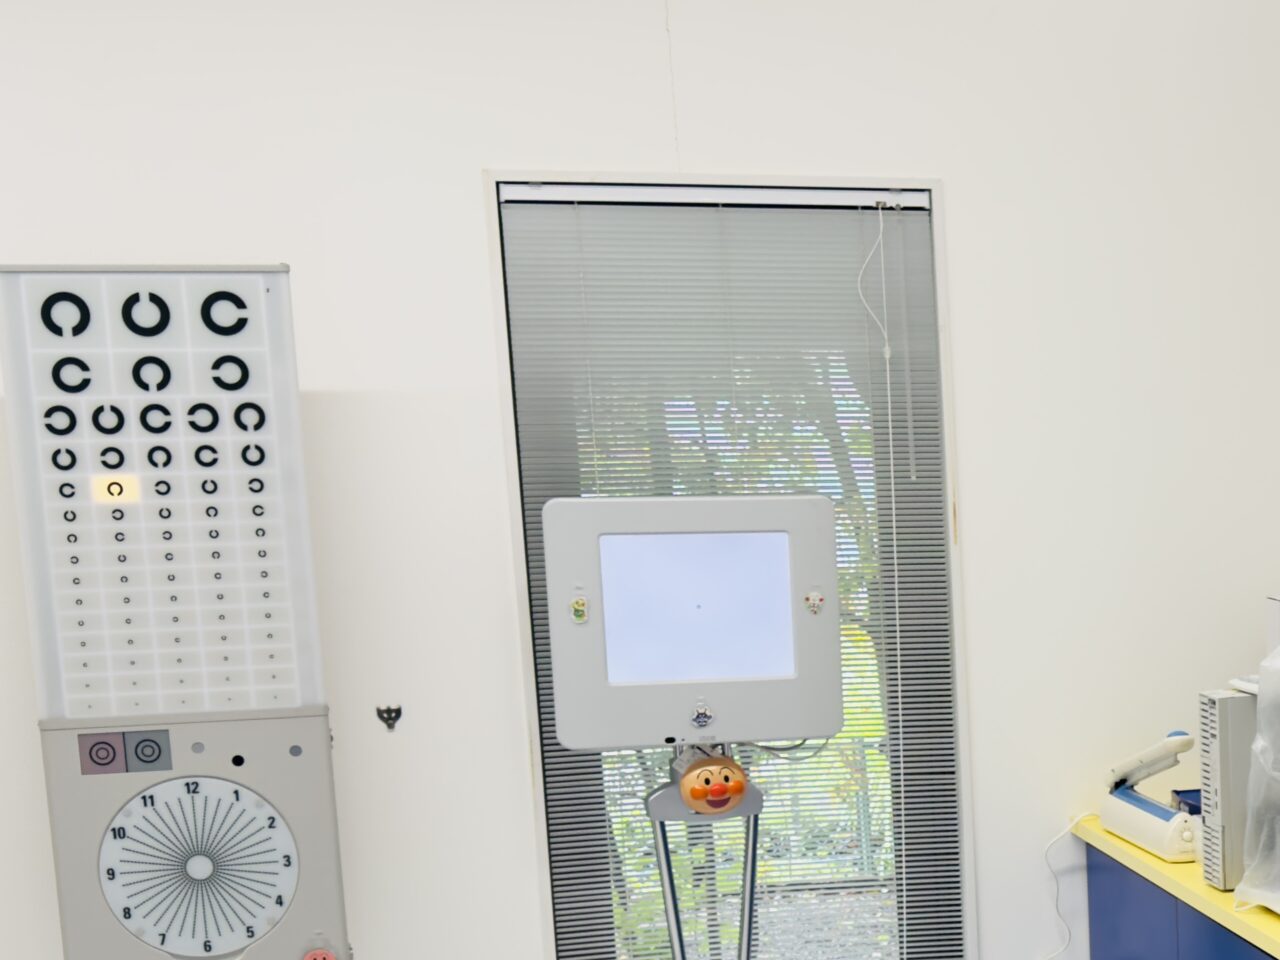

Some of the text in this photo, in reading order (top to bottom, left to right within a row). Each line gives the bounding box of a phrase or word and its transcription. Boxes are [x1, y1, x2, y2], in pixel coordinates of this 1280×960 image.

[184, 781, 200, 795] 12
[141, 795, 155, 808] 11
[233, 789, 240, 802] 1
[267, 816, 276, 829] 2
[110, 826, 126, 840] 10
[282, 855, 291, 868] 3
[106, 867, 116, 881] 9
[275, 894, 284, 907] 4
[122, 906, 132, 920] 8
[246, 925, 255, 939] 5
[158, 933, 166, 946] 7
[203, 939, 213, 953] 6
